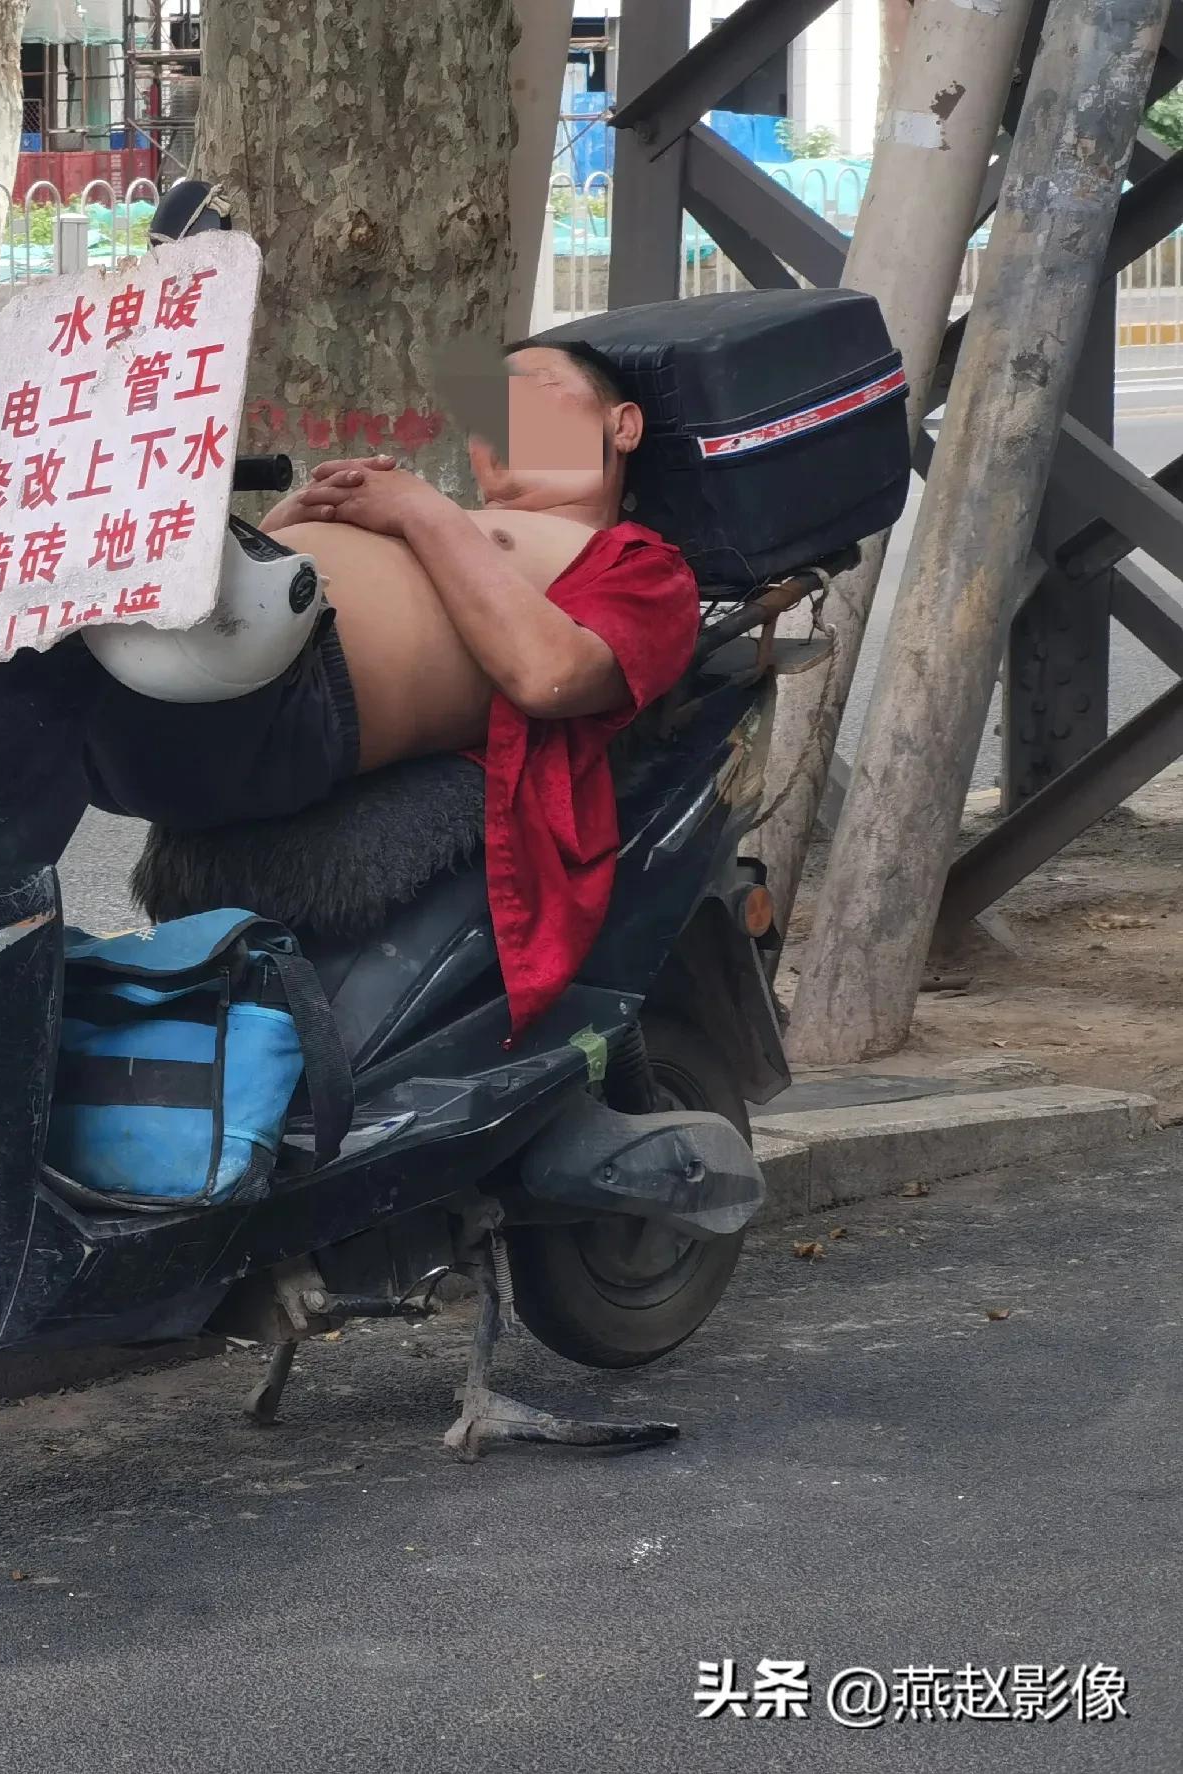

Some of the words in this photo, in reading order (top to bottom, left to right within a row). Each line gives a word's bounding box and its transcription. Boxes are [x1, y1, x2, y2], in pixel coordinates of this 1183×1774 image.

[49, 268, 218, 357] 水电暖
[1, 370, 97, 440] 电工
[123, 342, 226, 417] 管工
[88, 499, 196, 573] 地砖
